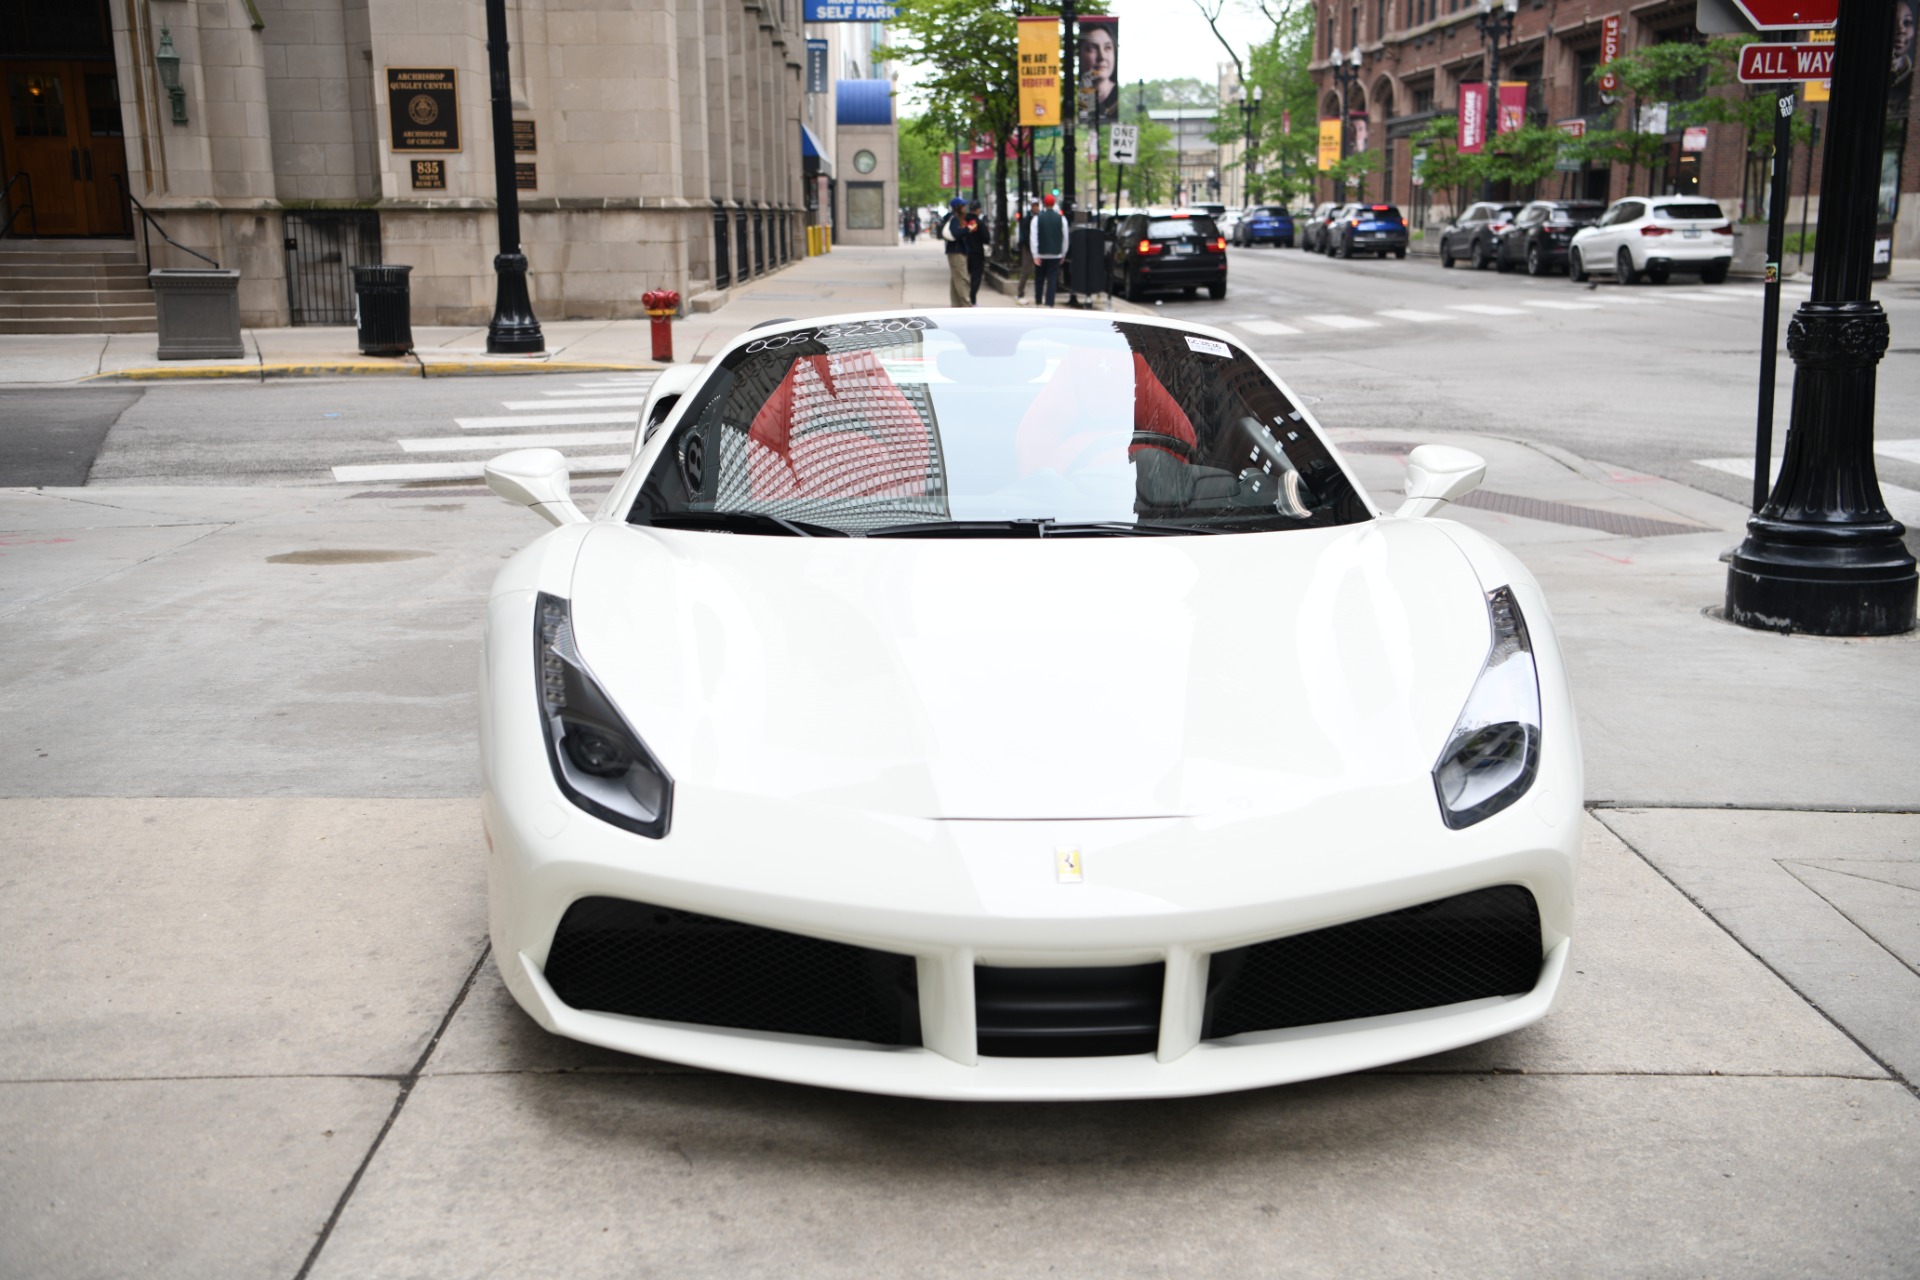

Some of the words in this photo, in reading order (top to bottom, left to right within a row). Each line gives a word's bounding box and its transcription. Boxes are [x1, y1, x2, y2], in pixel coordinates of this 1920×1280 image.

[816, 6, 853, 19] SELF
[856, 6, 897, 19] PARK
[1021, 54, 1032, 64] WE
[1034, 54, 1047, 63] ARE
[1750, 52, 1788, 74] ALL
[1797, 51, 1835, 73] WAY
[1021, 66, 1046, 76] CALLED
[1048, 65, 1057, 75] TO
[397, 73, 445, 81] ARCHBISHOP
[1022, 78, 1055, 87] REDEFINE
[390, 82, 422, 91] QUIGLEY
[423, 82, 453, 90] CENTER
[1464, 91, 1476, 147] WELCOME
[1113, 127, 1135, 138] ONE
[1113, 139, 1134, 147] WAY
[417, 162, 439, 174] 835
[746, 320, 926, 353] 005132300
